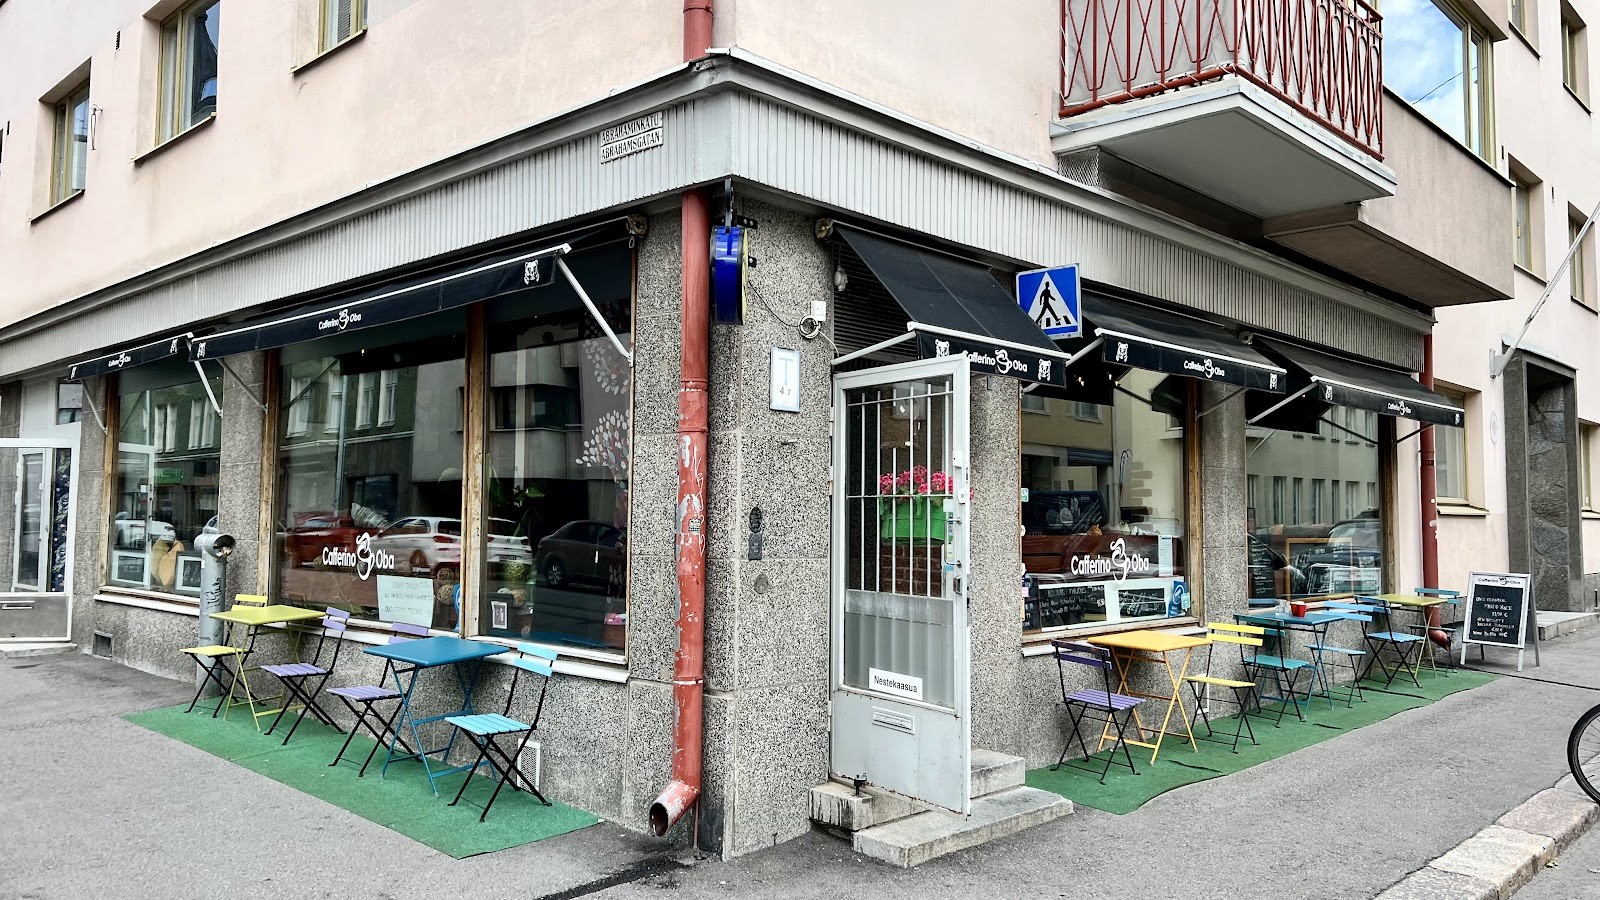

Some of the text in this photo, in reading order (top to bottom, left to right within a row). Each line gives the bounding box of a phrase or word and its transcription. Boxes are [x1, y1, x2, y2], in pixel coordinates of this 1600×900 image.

[602, 113, 660, 143] ABRAHAMINKATU
[602, 131, 660, 160] ABRAHAMSGATAN
[350, 313, 362, 322] Oba
[1012, 359, 1028, 372] Oba
[322, 546, 395, 569] Cafferino Oba
[1071, 554, 1112, 575] Cafferino
[1131, 553, 1150, 571] Oba
[873, 675, 918, 693] Nestekaasua
